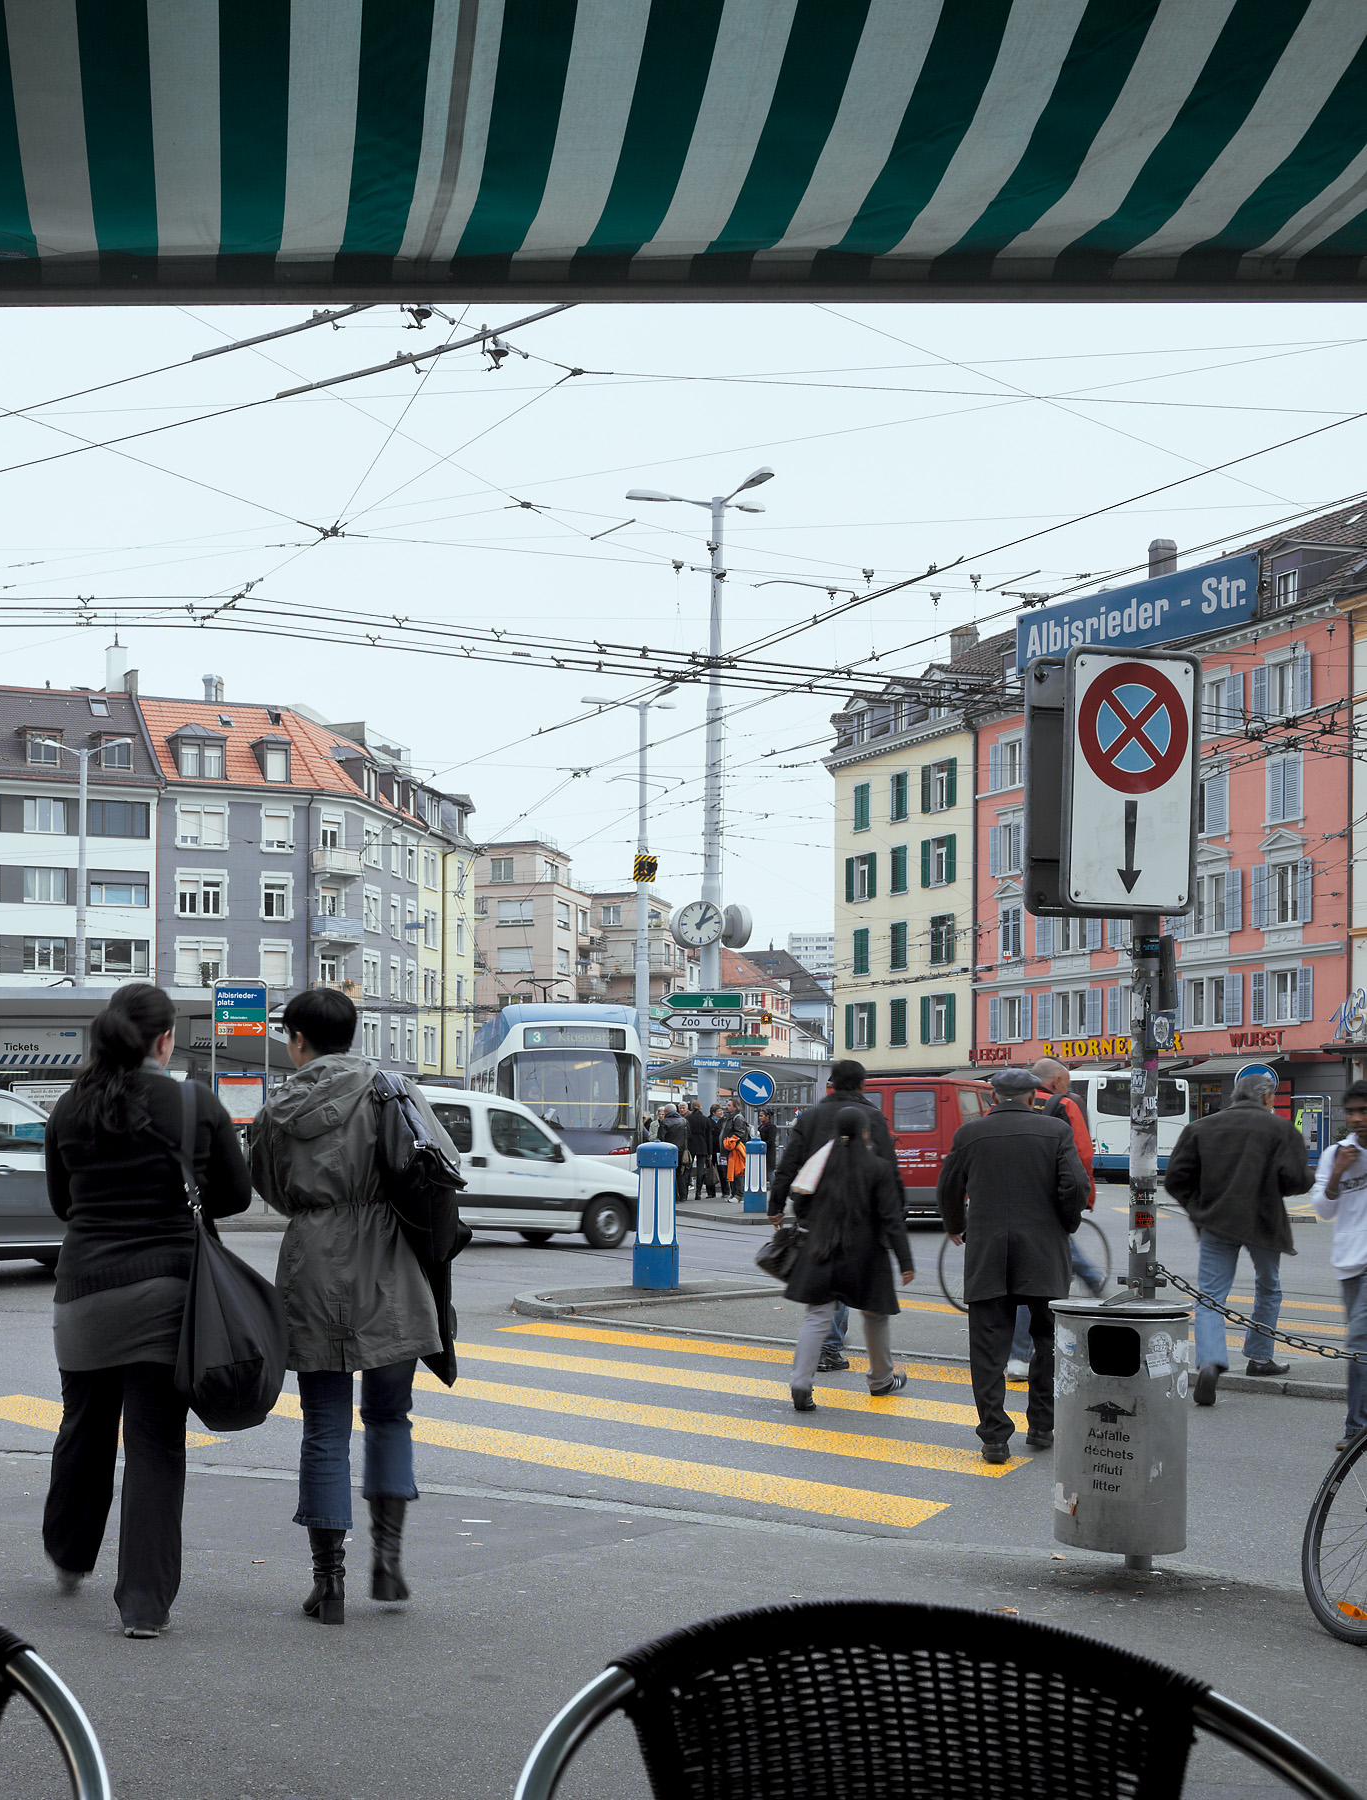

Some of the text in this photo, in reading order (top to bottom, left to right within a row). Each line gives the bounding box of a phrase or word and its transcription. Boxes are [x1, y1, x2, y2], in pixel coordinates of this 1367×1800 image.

[1026, 598, 1170, 659] Albisrieder
[1201, 576, 1247, 615] Str.
[217, 991, 257, 999] Albisrieder-
[217, 999, 234, 1007] platz
[222, 1011, 229, 1020] 3
[681, 1016, 700, 1027] Zoo
[711, 1016, 732, 1029] City
[533, 1031, 614, 1043] 3 Klusplatz
[1229, 1030, 1285, 1048] WURST
[4, 1043, 40, 1051] Tickets
[968, 1048, 1012, 1061] FLEISCH
[694, 1059, 721, 1067] Albisrieder
[1088, 1428, 1130, 1443] Abfälle
[1084, 1445, 1134, 1460] déchets
[1093, 1462, 1123, 1476] rifiuti
[1093, 1479, 1121, 1493] litter
